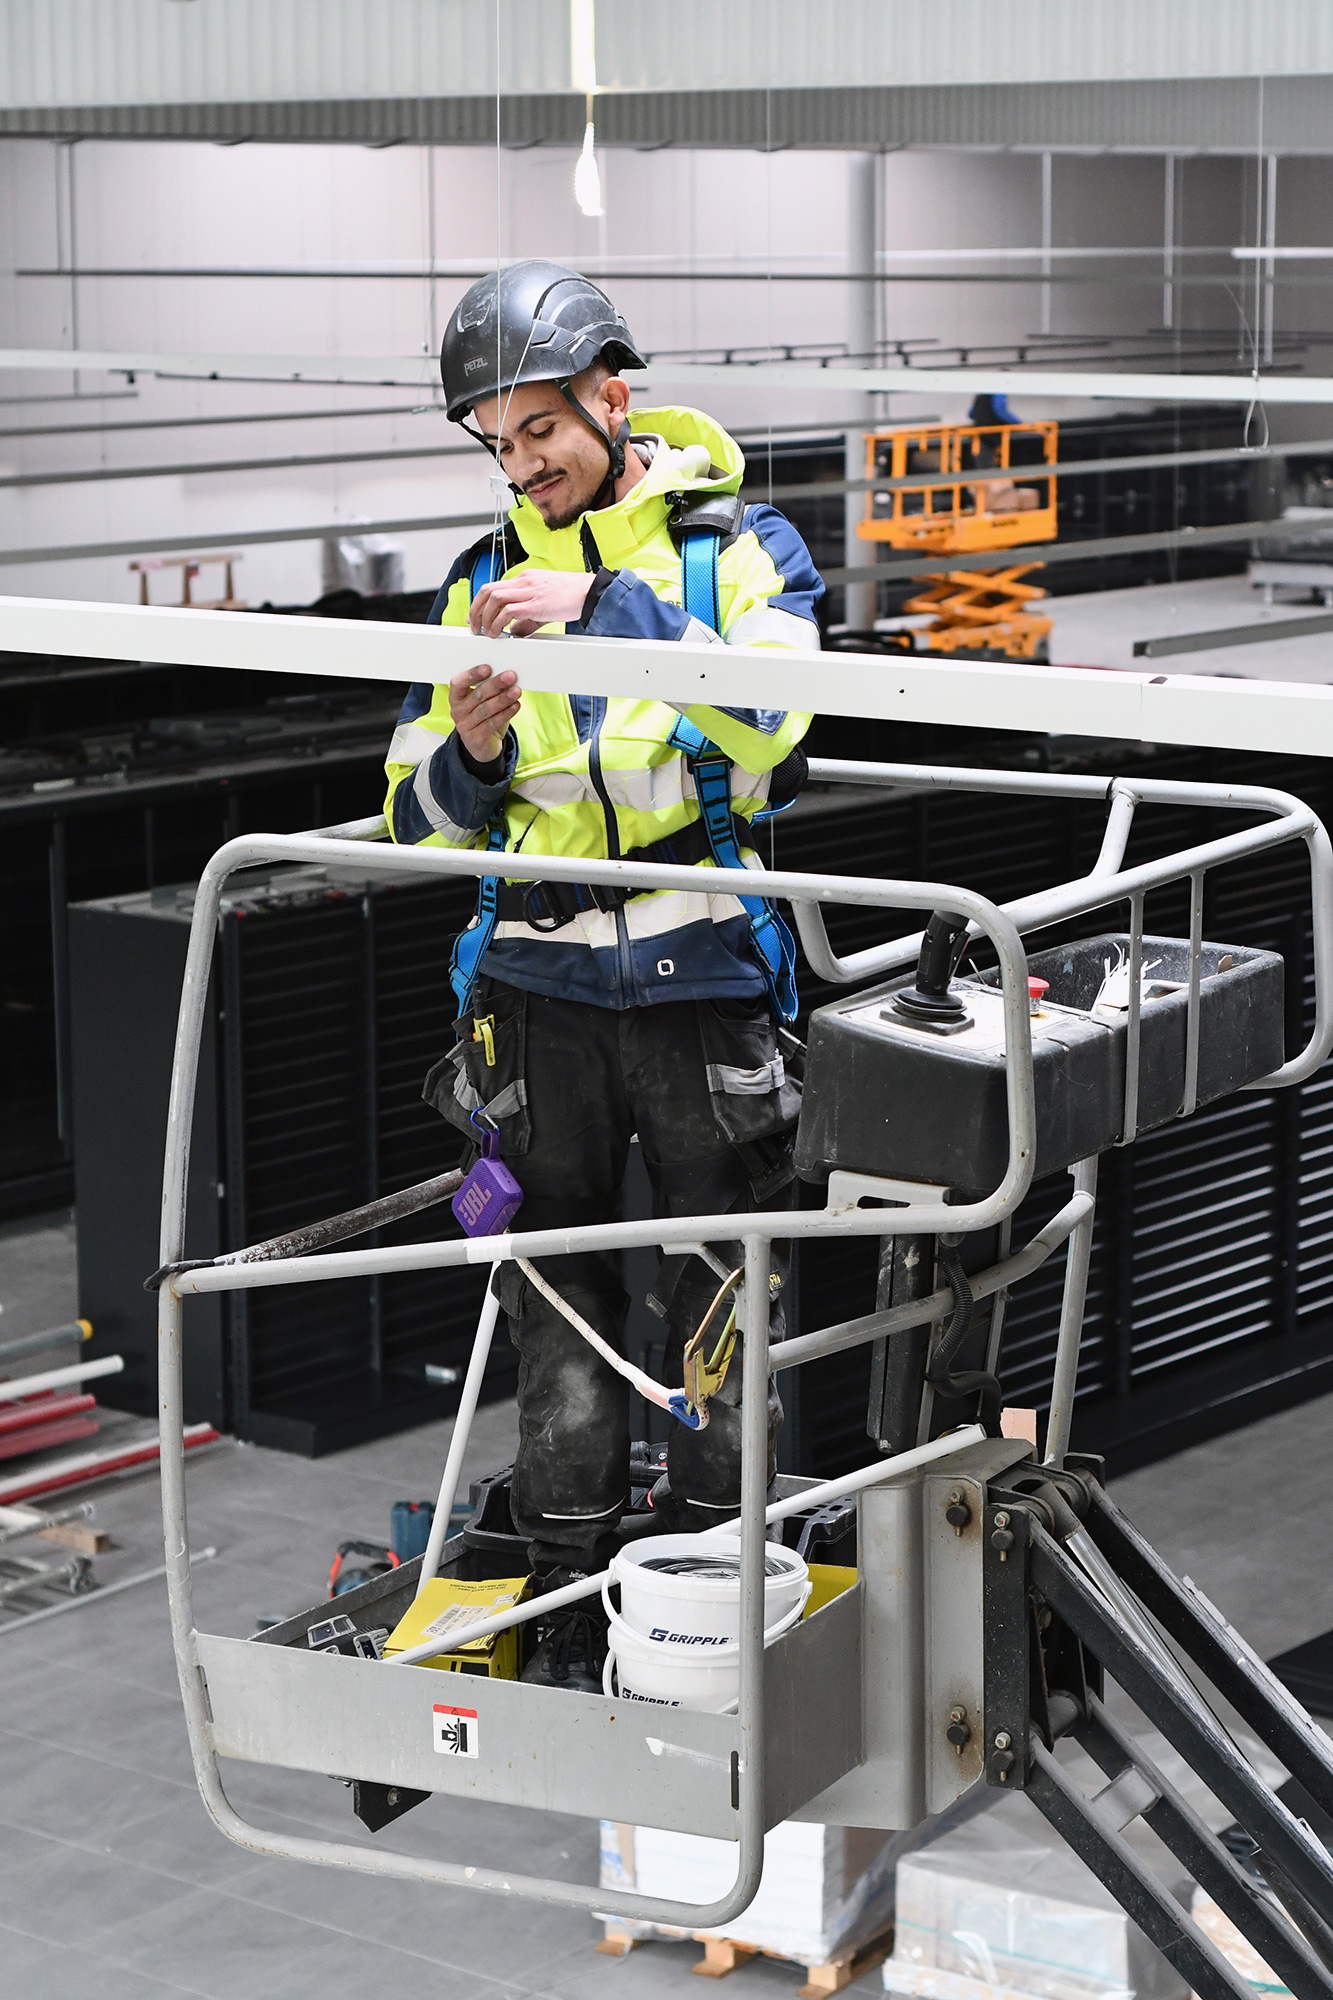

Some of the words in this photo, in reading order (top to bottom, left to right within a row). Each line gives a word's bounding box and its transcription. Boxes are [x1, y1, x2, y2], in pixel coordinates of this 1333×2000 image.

[464, 357, 488, 377] PETZL
[457, 1181, 492, 1226] JBL
[668, 1633, 730, 1645] GRIPPLE
